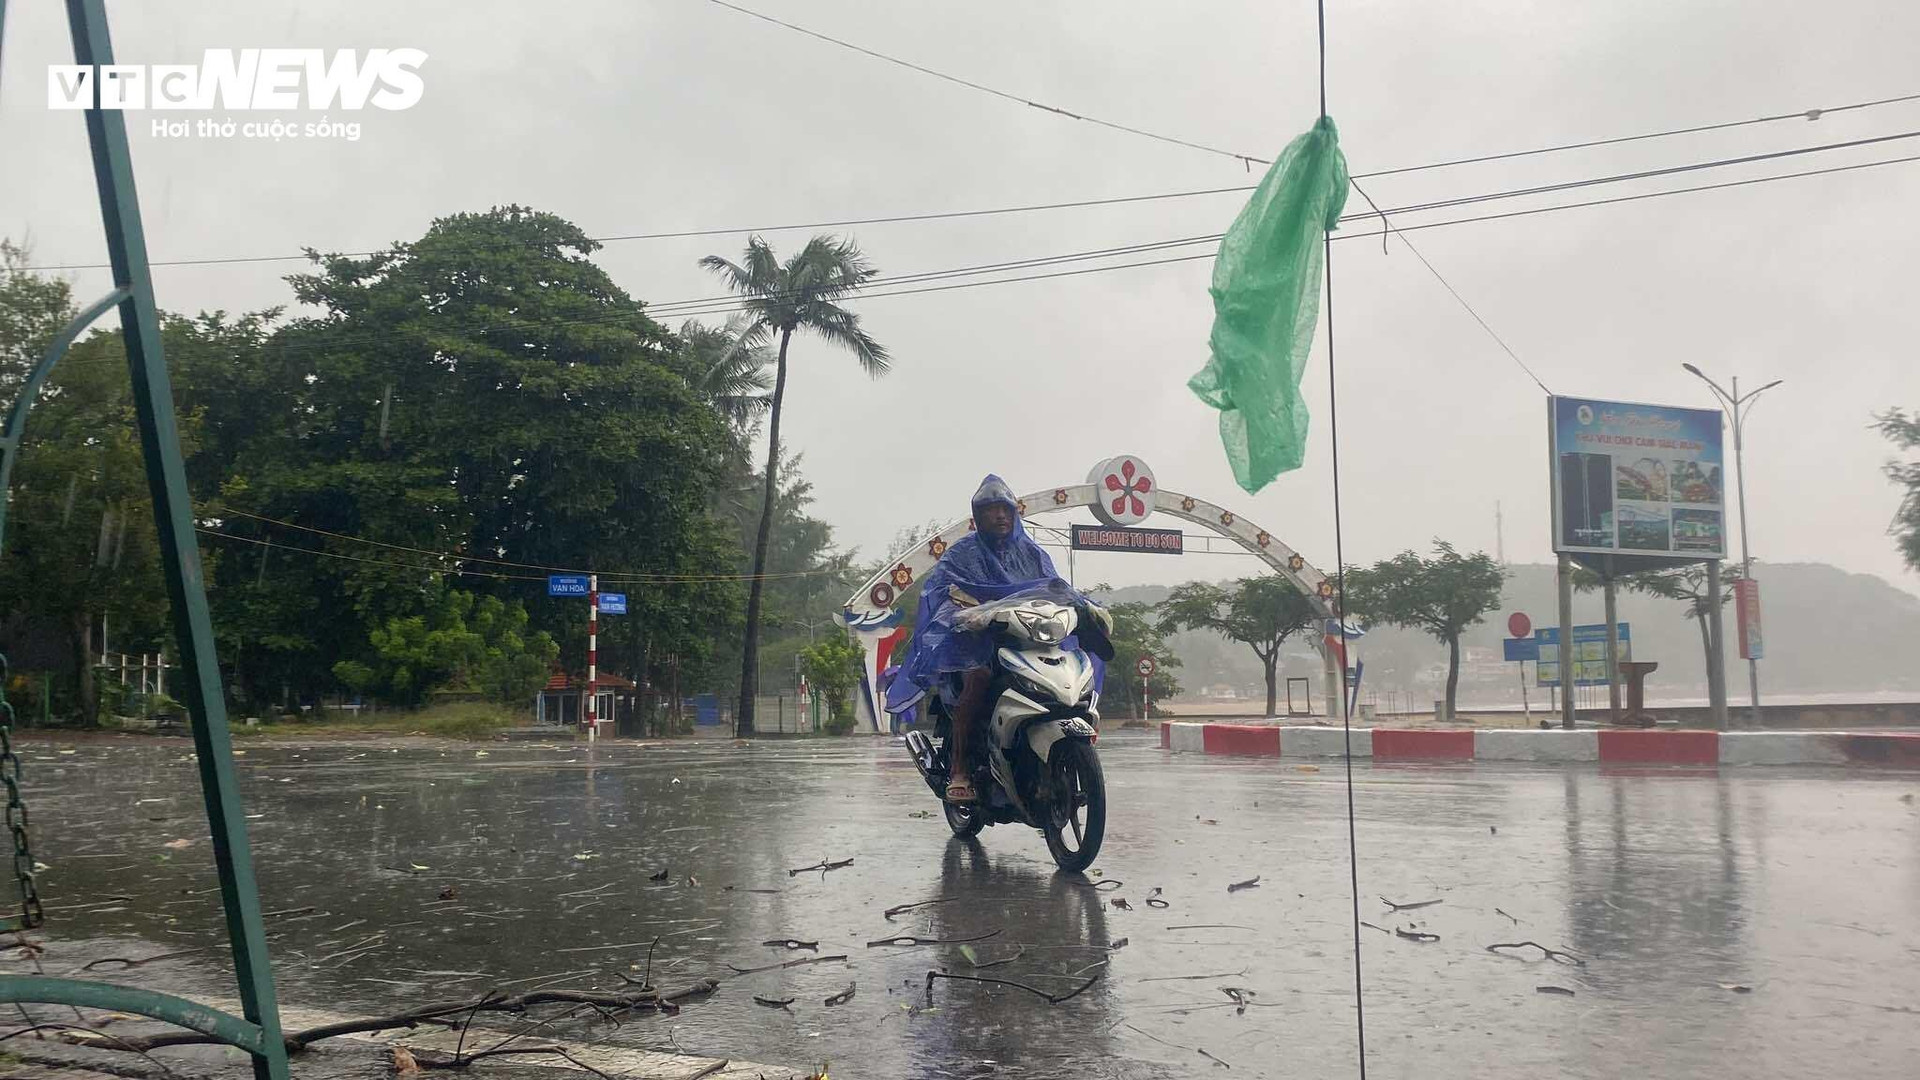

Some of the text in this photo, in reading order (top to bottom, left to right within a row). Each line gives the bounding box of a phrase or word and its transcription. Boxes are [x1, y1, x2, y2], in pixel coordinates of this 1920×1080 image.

[1078, 530, 1182, 549] WELCOME TO DO SON
